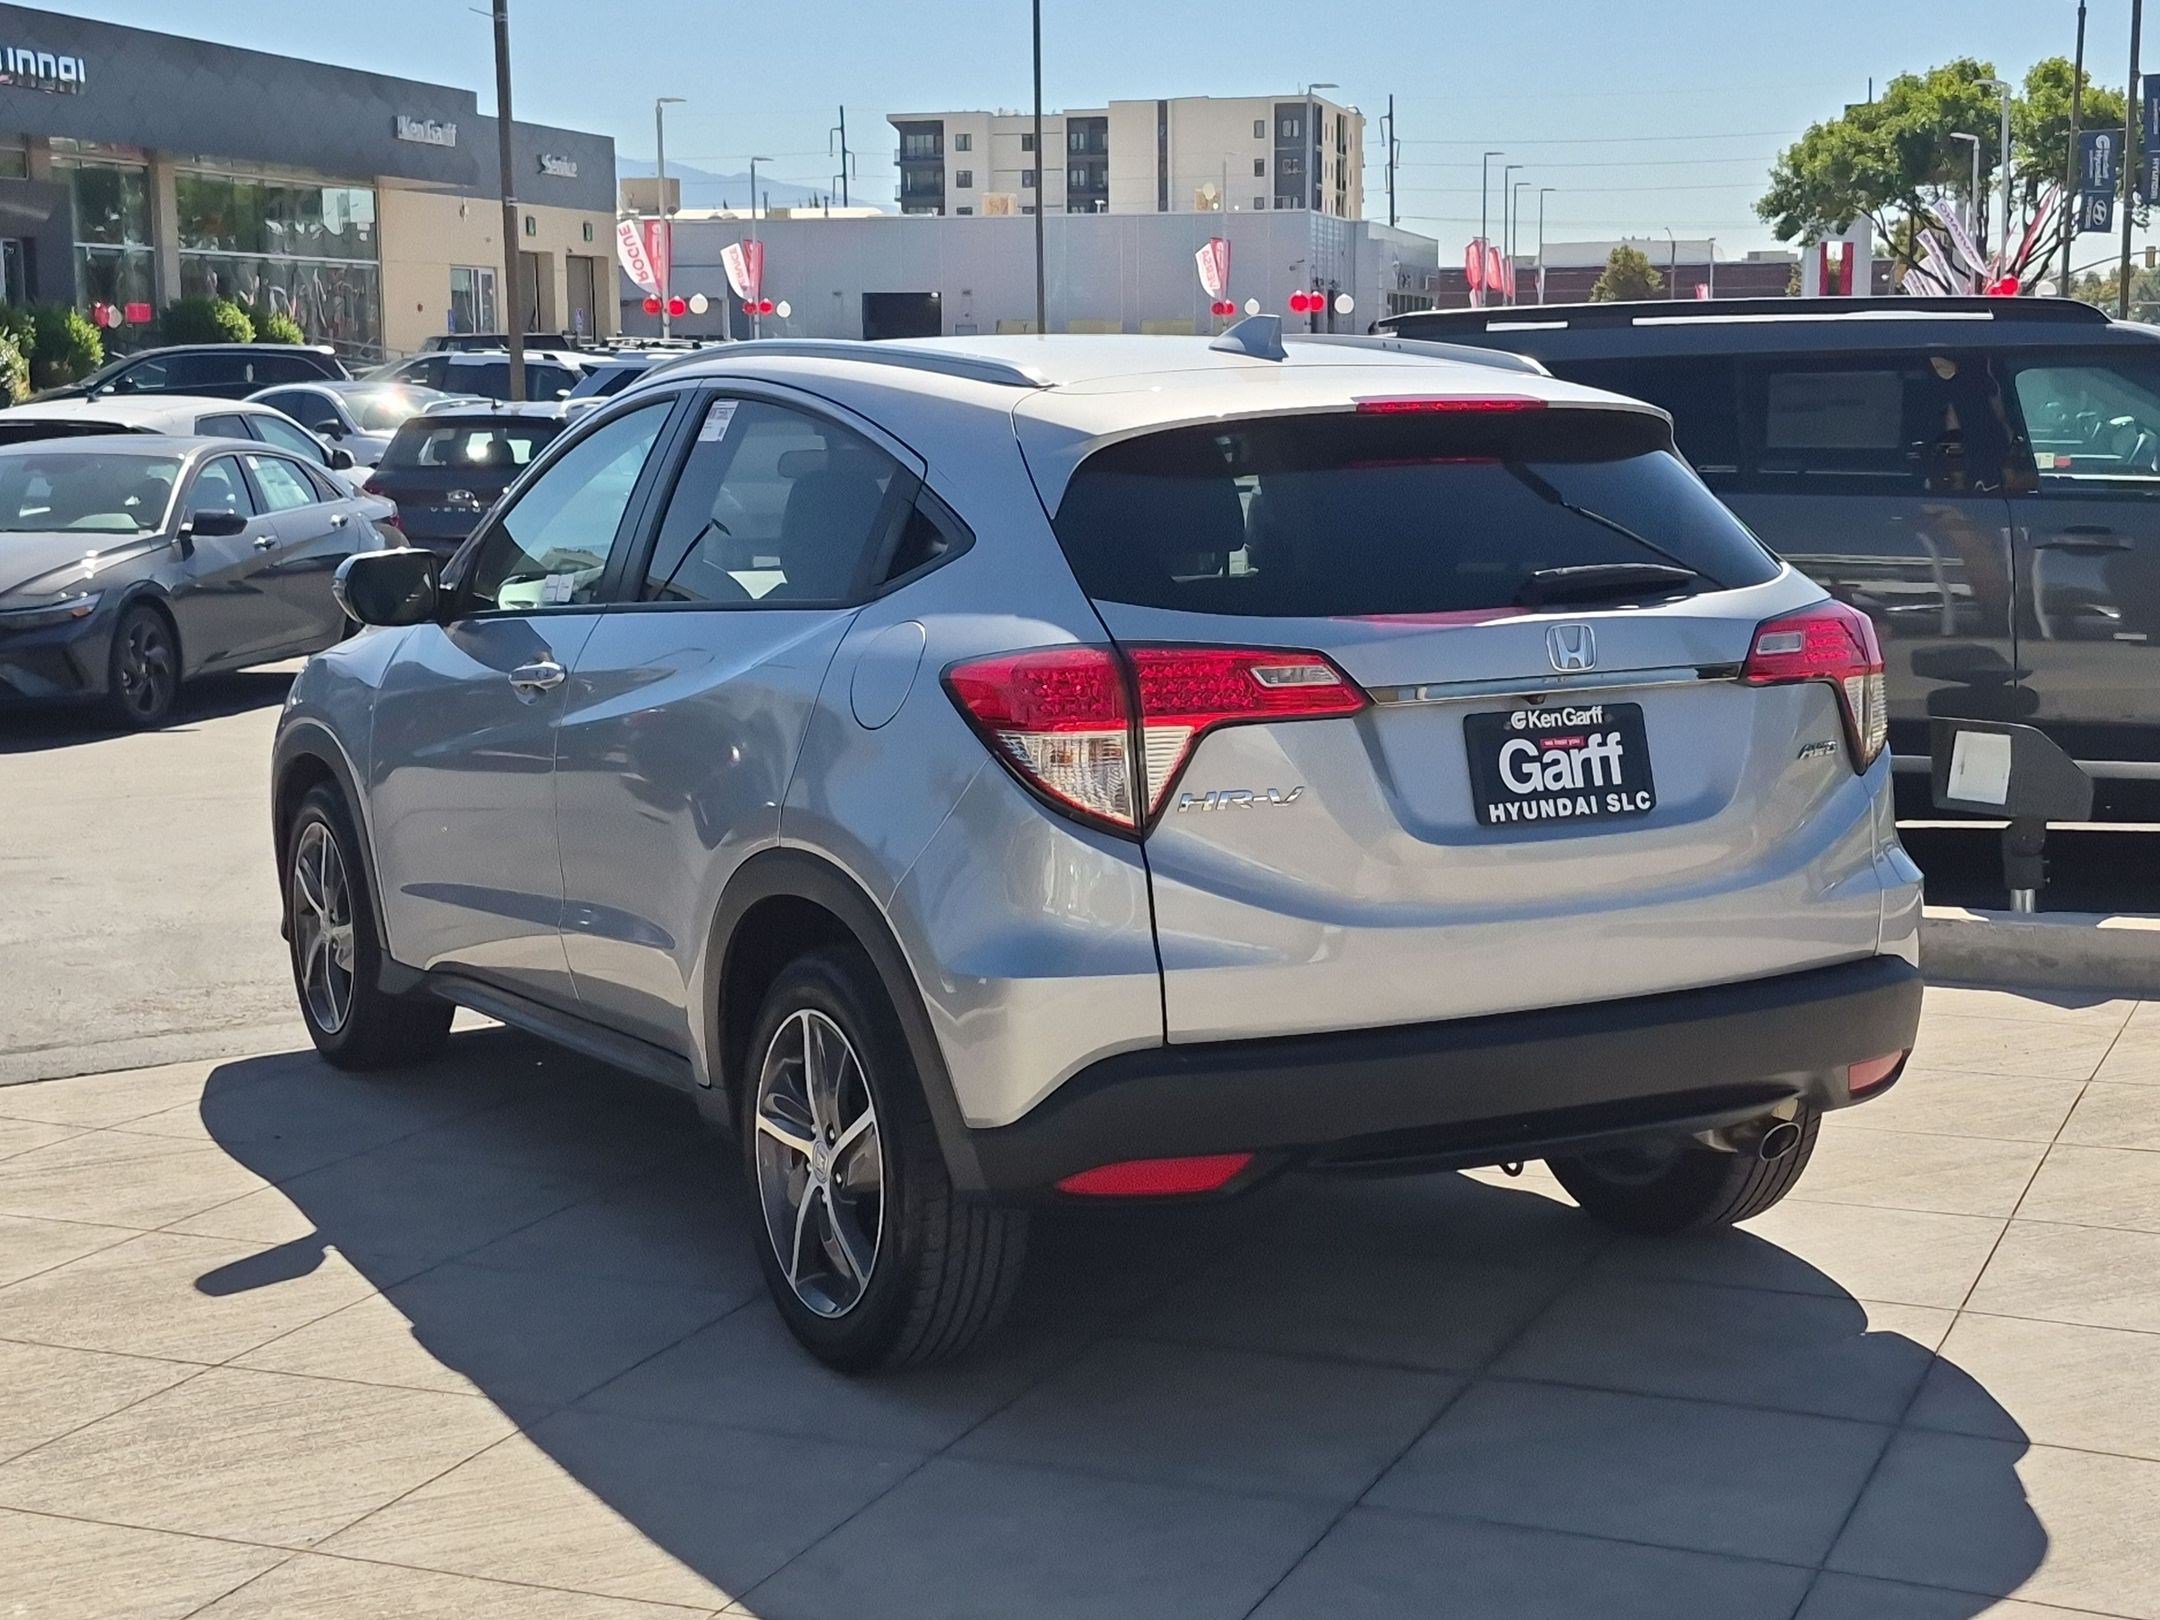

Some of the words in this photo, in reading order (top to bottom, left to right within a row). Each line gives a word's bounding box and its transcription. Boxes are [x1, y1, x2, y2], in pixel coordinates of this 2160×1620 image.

[1528, 710, 1562, 729] Ken
[1562, 706, 1603, 729] Garff
[1499, 732, 1623, 794] Garff
[1178, 786, 1305, 813] HR-V
[1489, 795, 1598, 823] HYUNDAI
[1606, 791, 1651, 813] SLC
